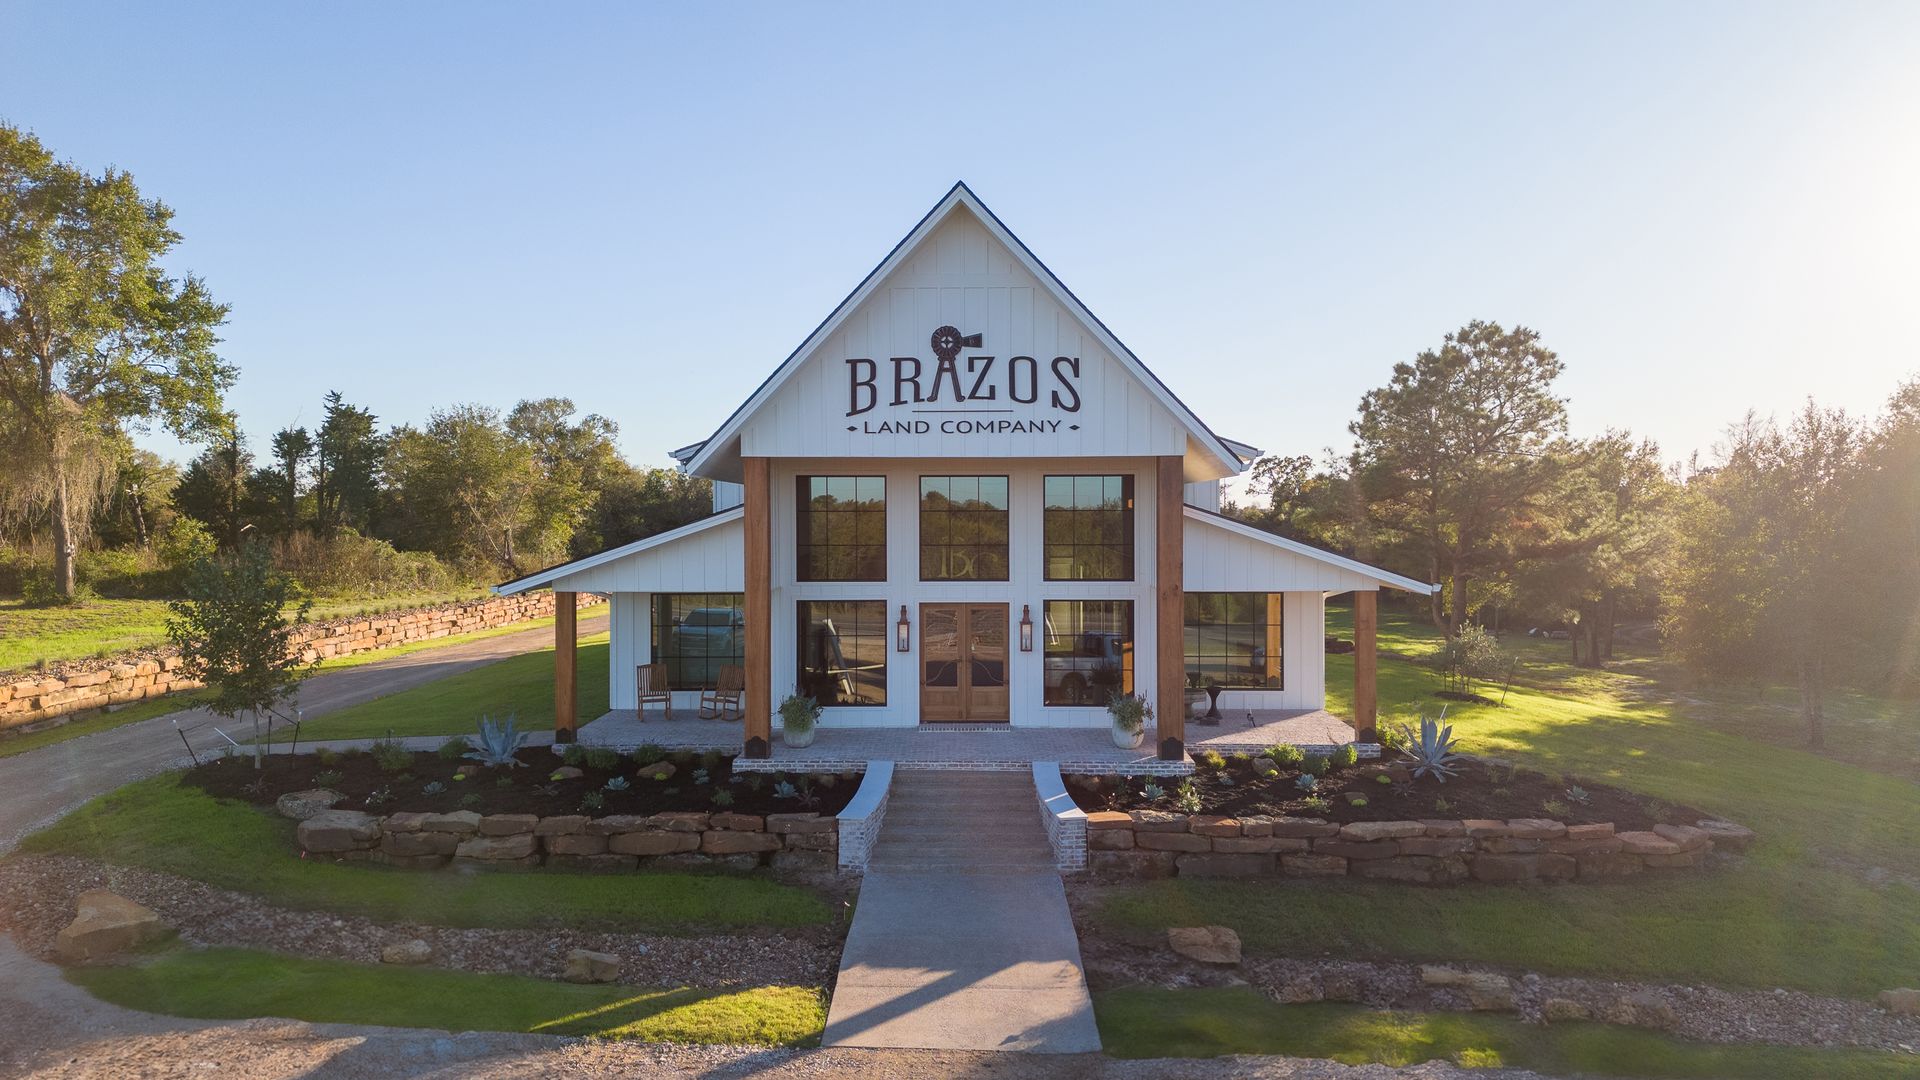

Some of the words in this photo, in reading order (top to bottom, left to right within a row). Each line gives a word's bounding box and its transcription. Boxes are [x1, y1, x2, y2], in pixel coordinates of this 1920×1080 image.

[845, 356, 1081, 417] BRAZOS
[864, 420, 930, 434] LAND
[940, 420, 1062, 434] COMPANY
